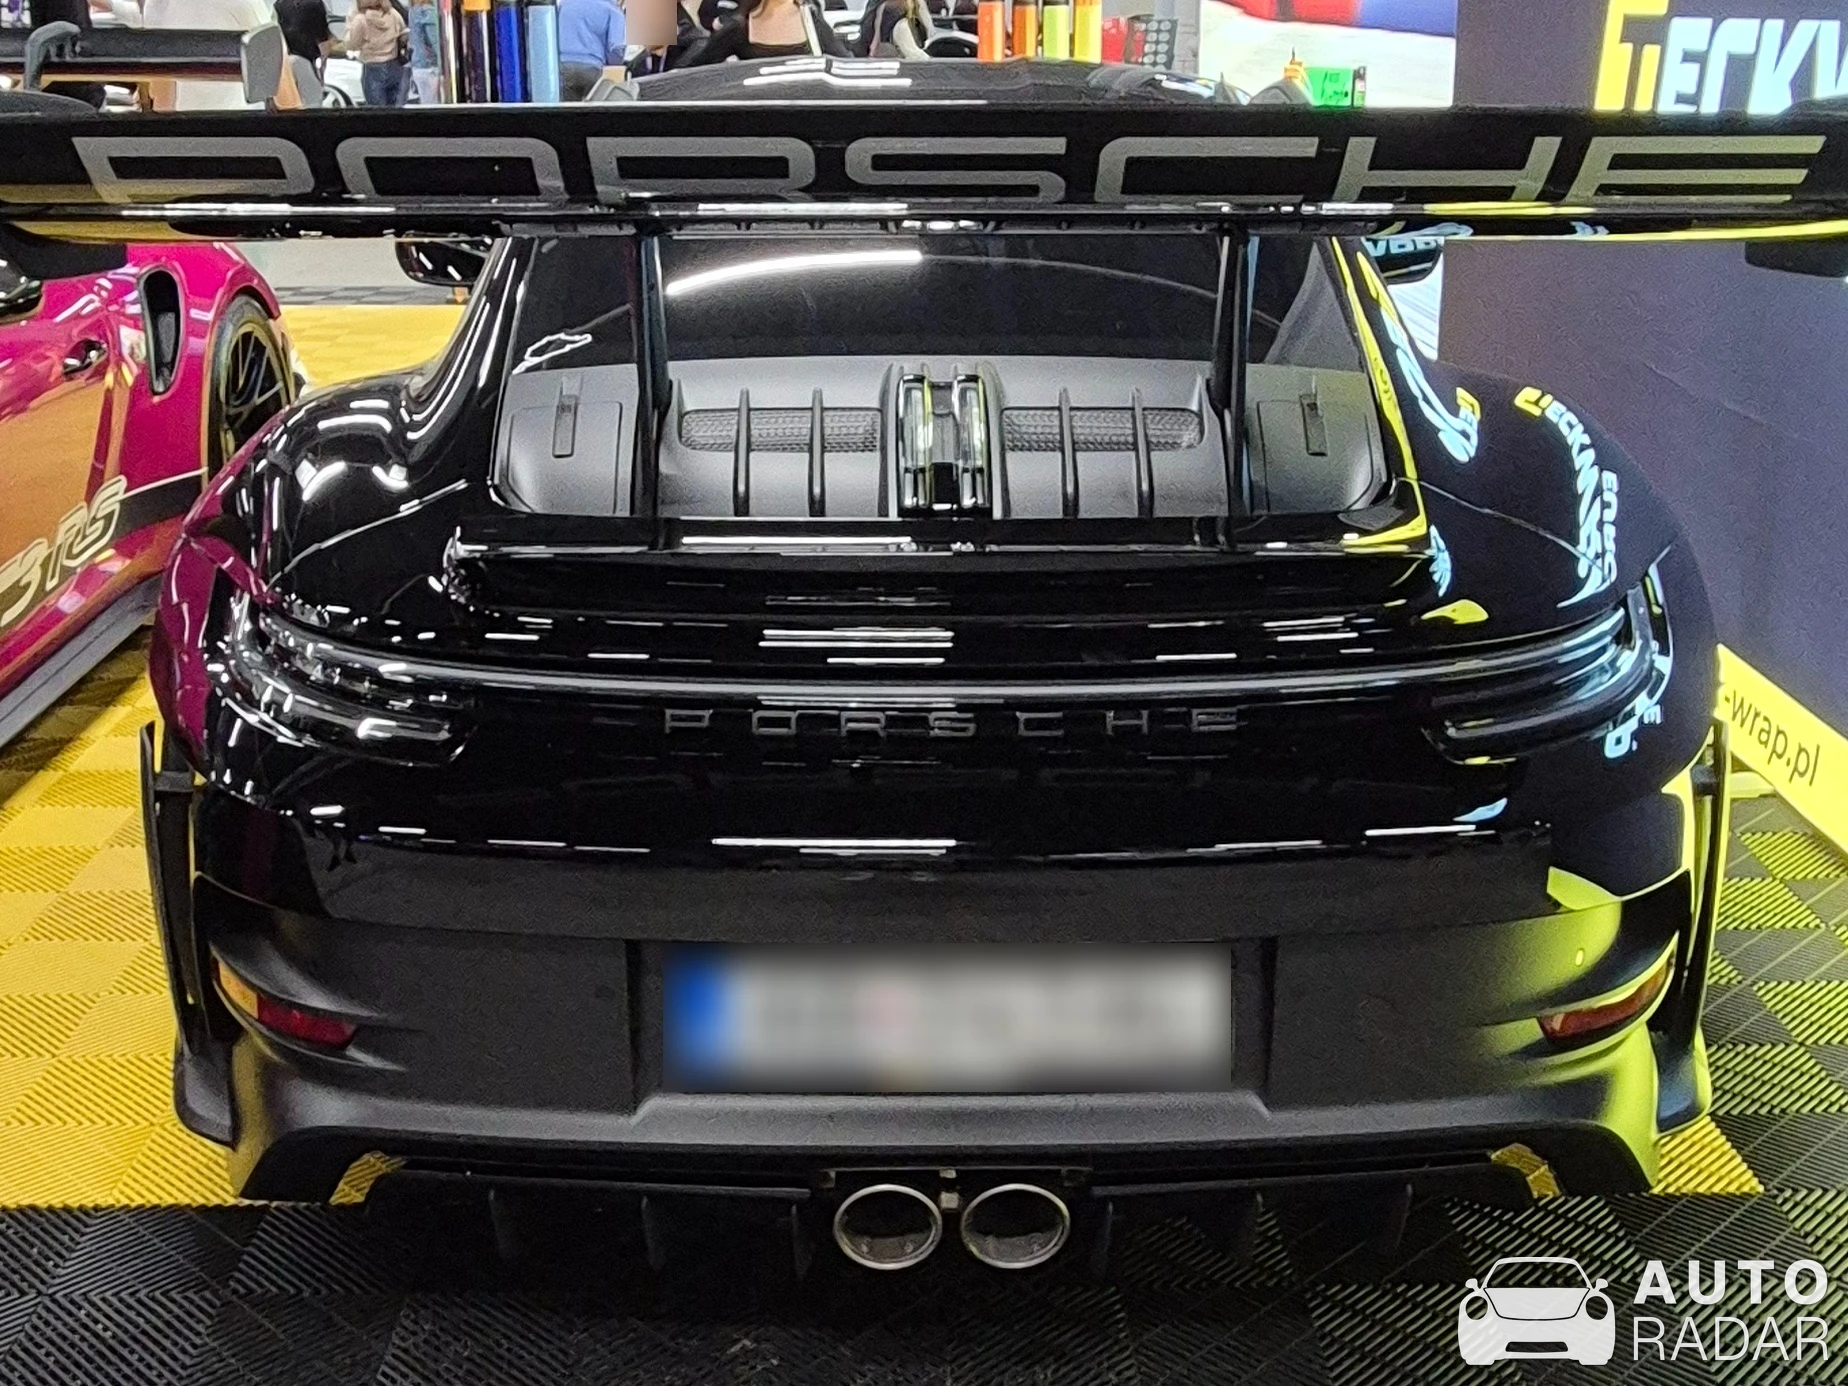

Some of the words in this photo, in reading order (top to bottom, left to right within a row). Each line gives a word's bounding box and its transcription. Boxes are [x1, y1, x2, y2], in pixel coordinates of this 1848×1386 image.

[71, 135, 1826, 203] PORSCHE
[664, 707, 1239, 737] PORSCHE
[1723, 689, 1821, 787] -wrap.pl
